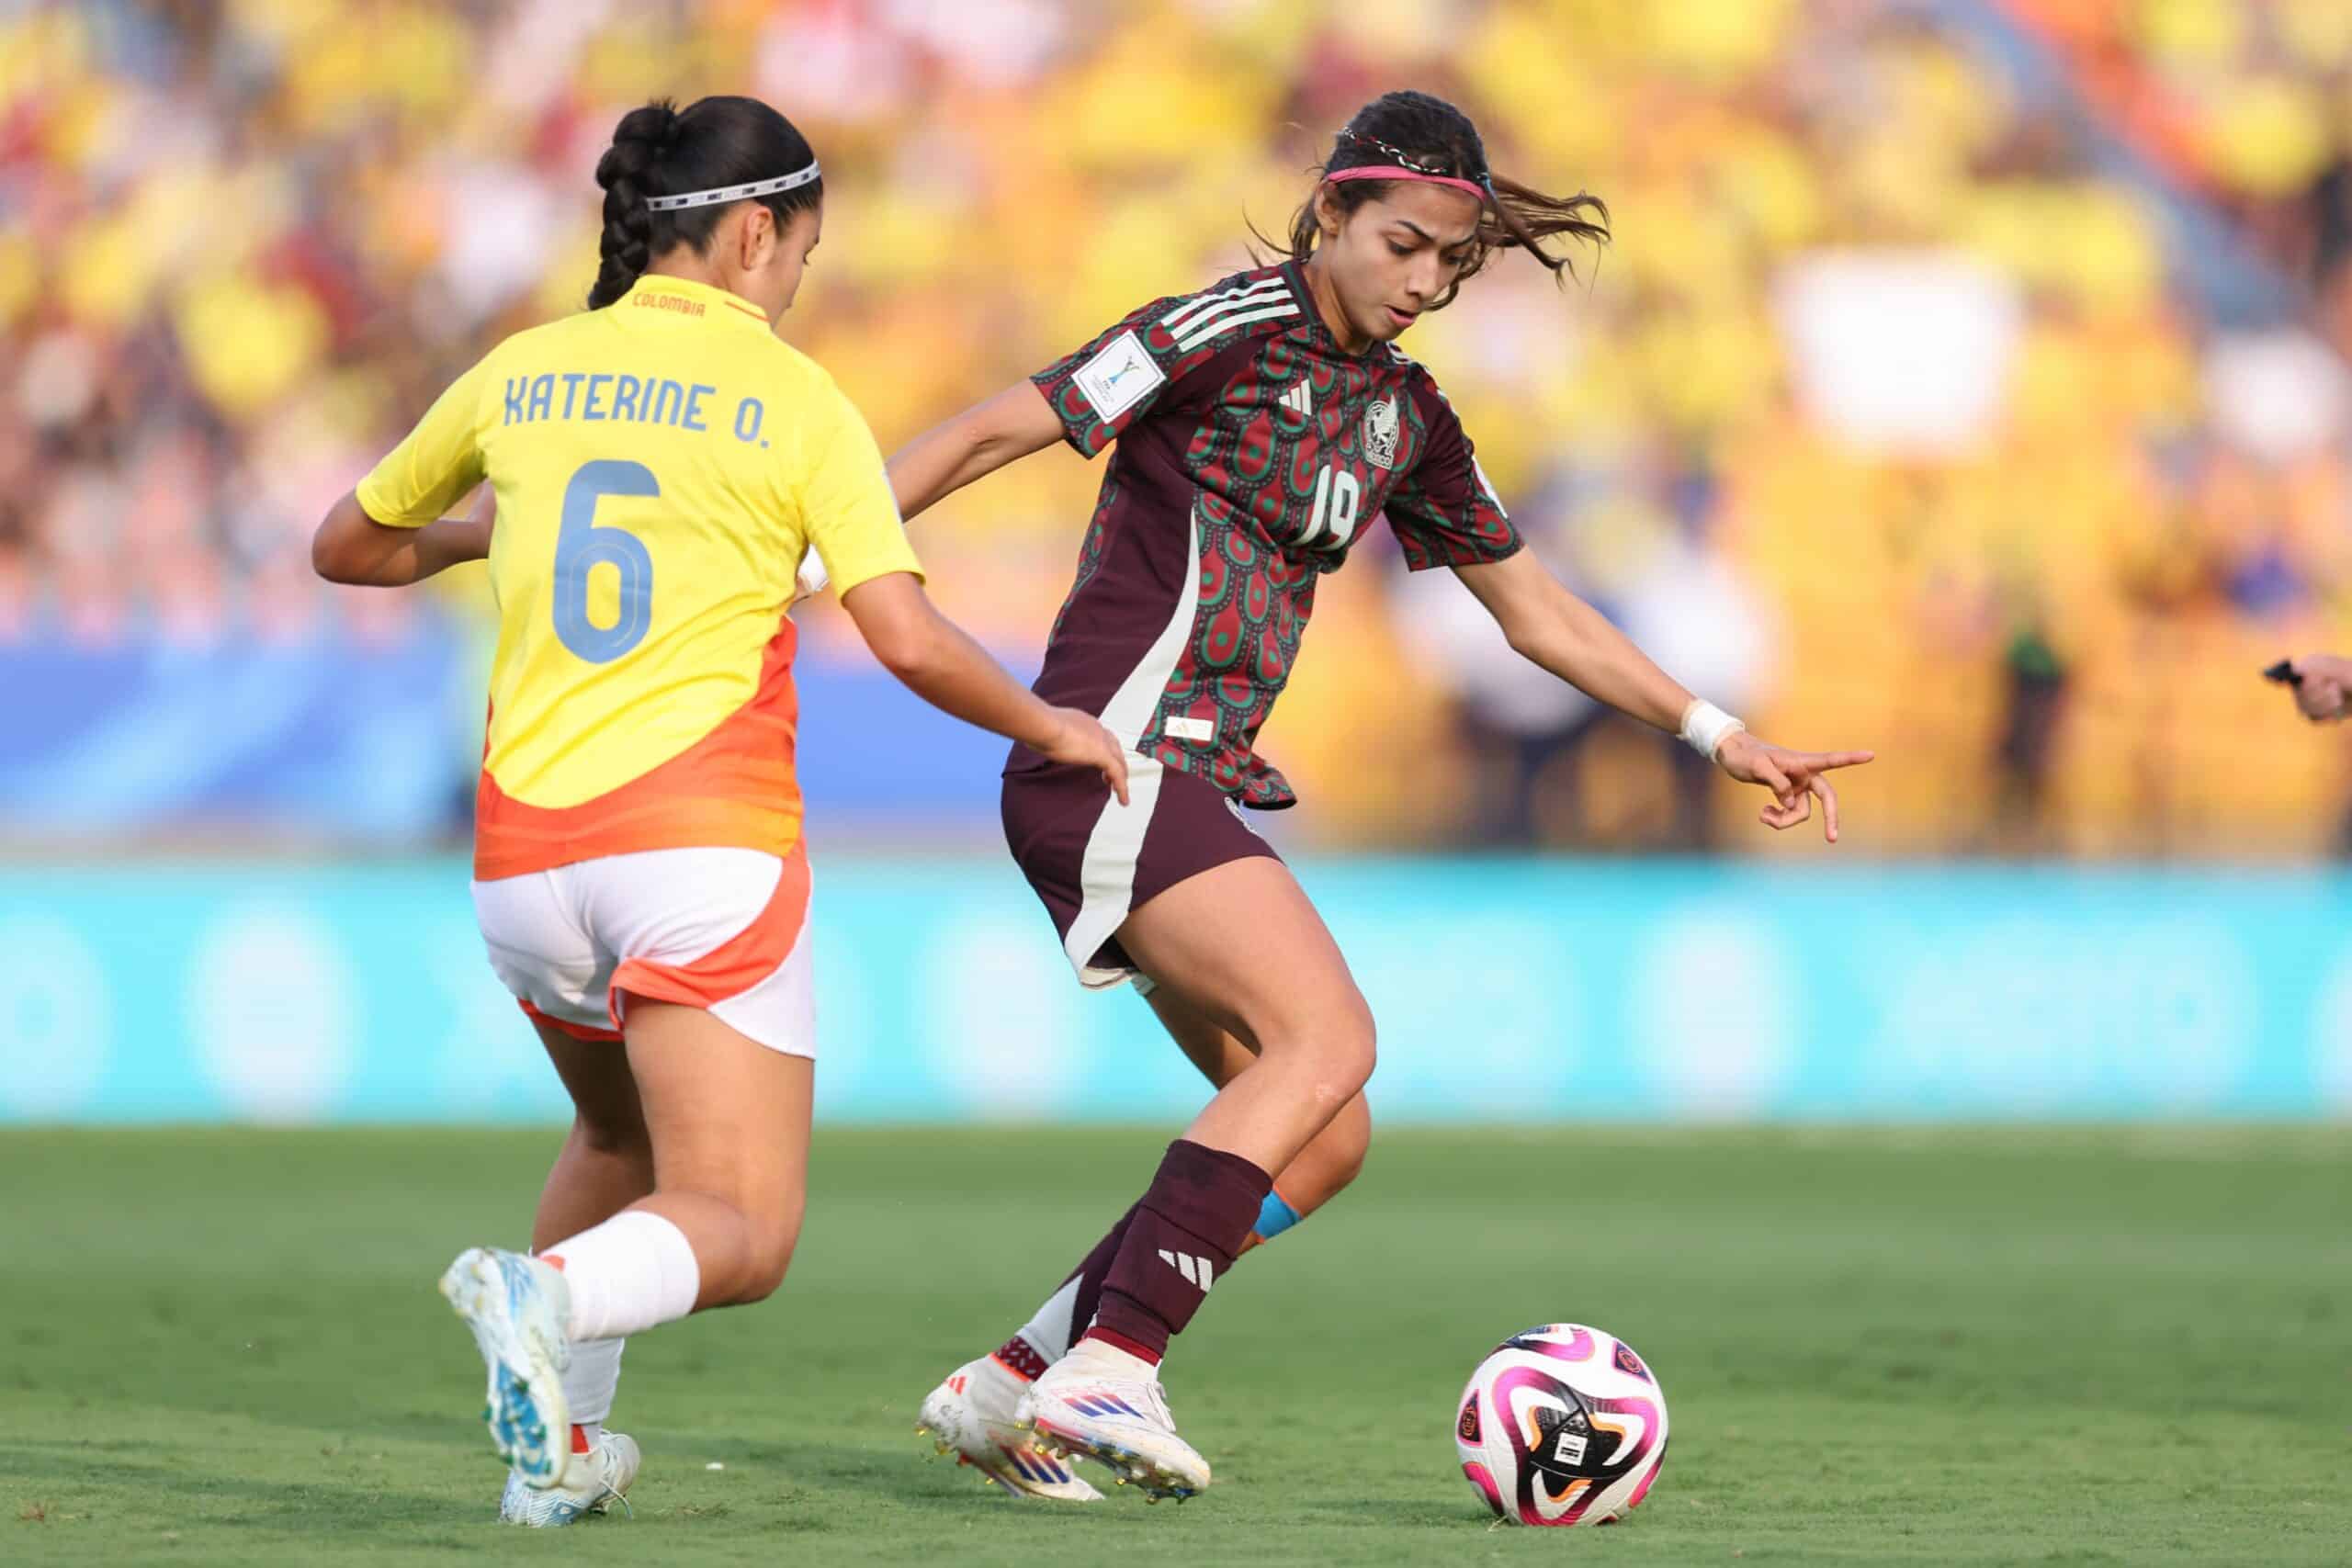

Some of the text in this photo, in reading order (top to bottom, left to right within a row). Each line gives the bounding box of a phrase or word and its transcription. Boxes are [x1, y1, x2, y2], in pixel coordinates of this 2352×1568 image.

[632, 292, 707, 317] COLOMBIA
[504, 373, 770, 449] KATERINE O.
[1290, 464, 1360, 551] 19
[552, 459, 661, 664] 6
